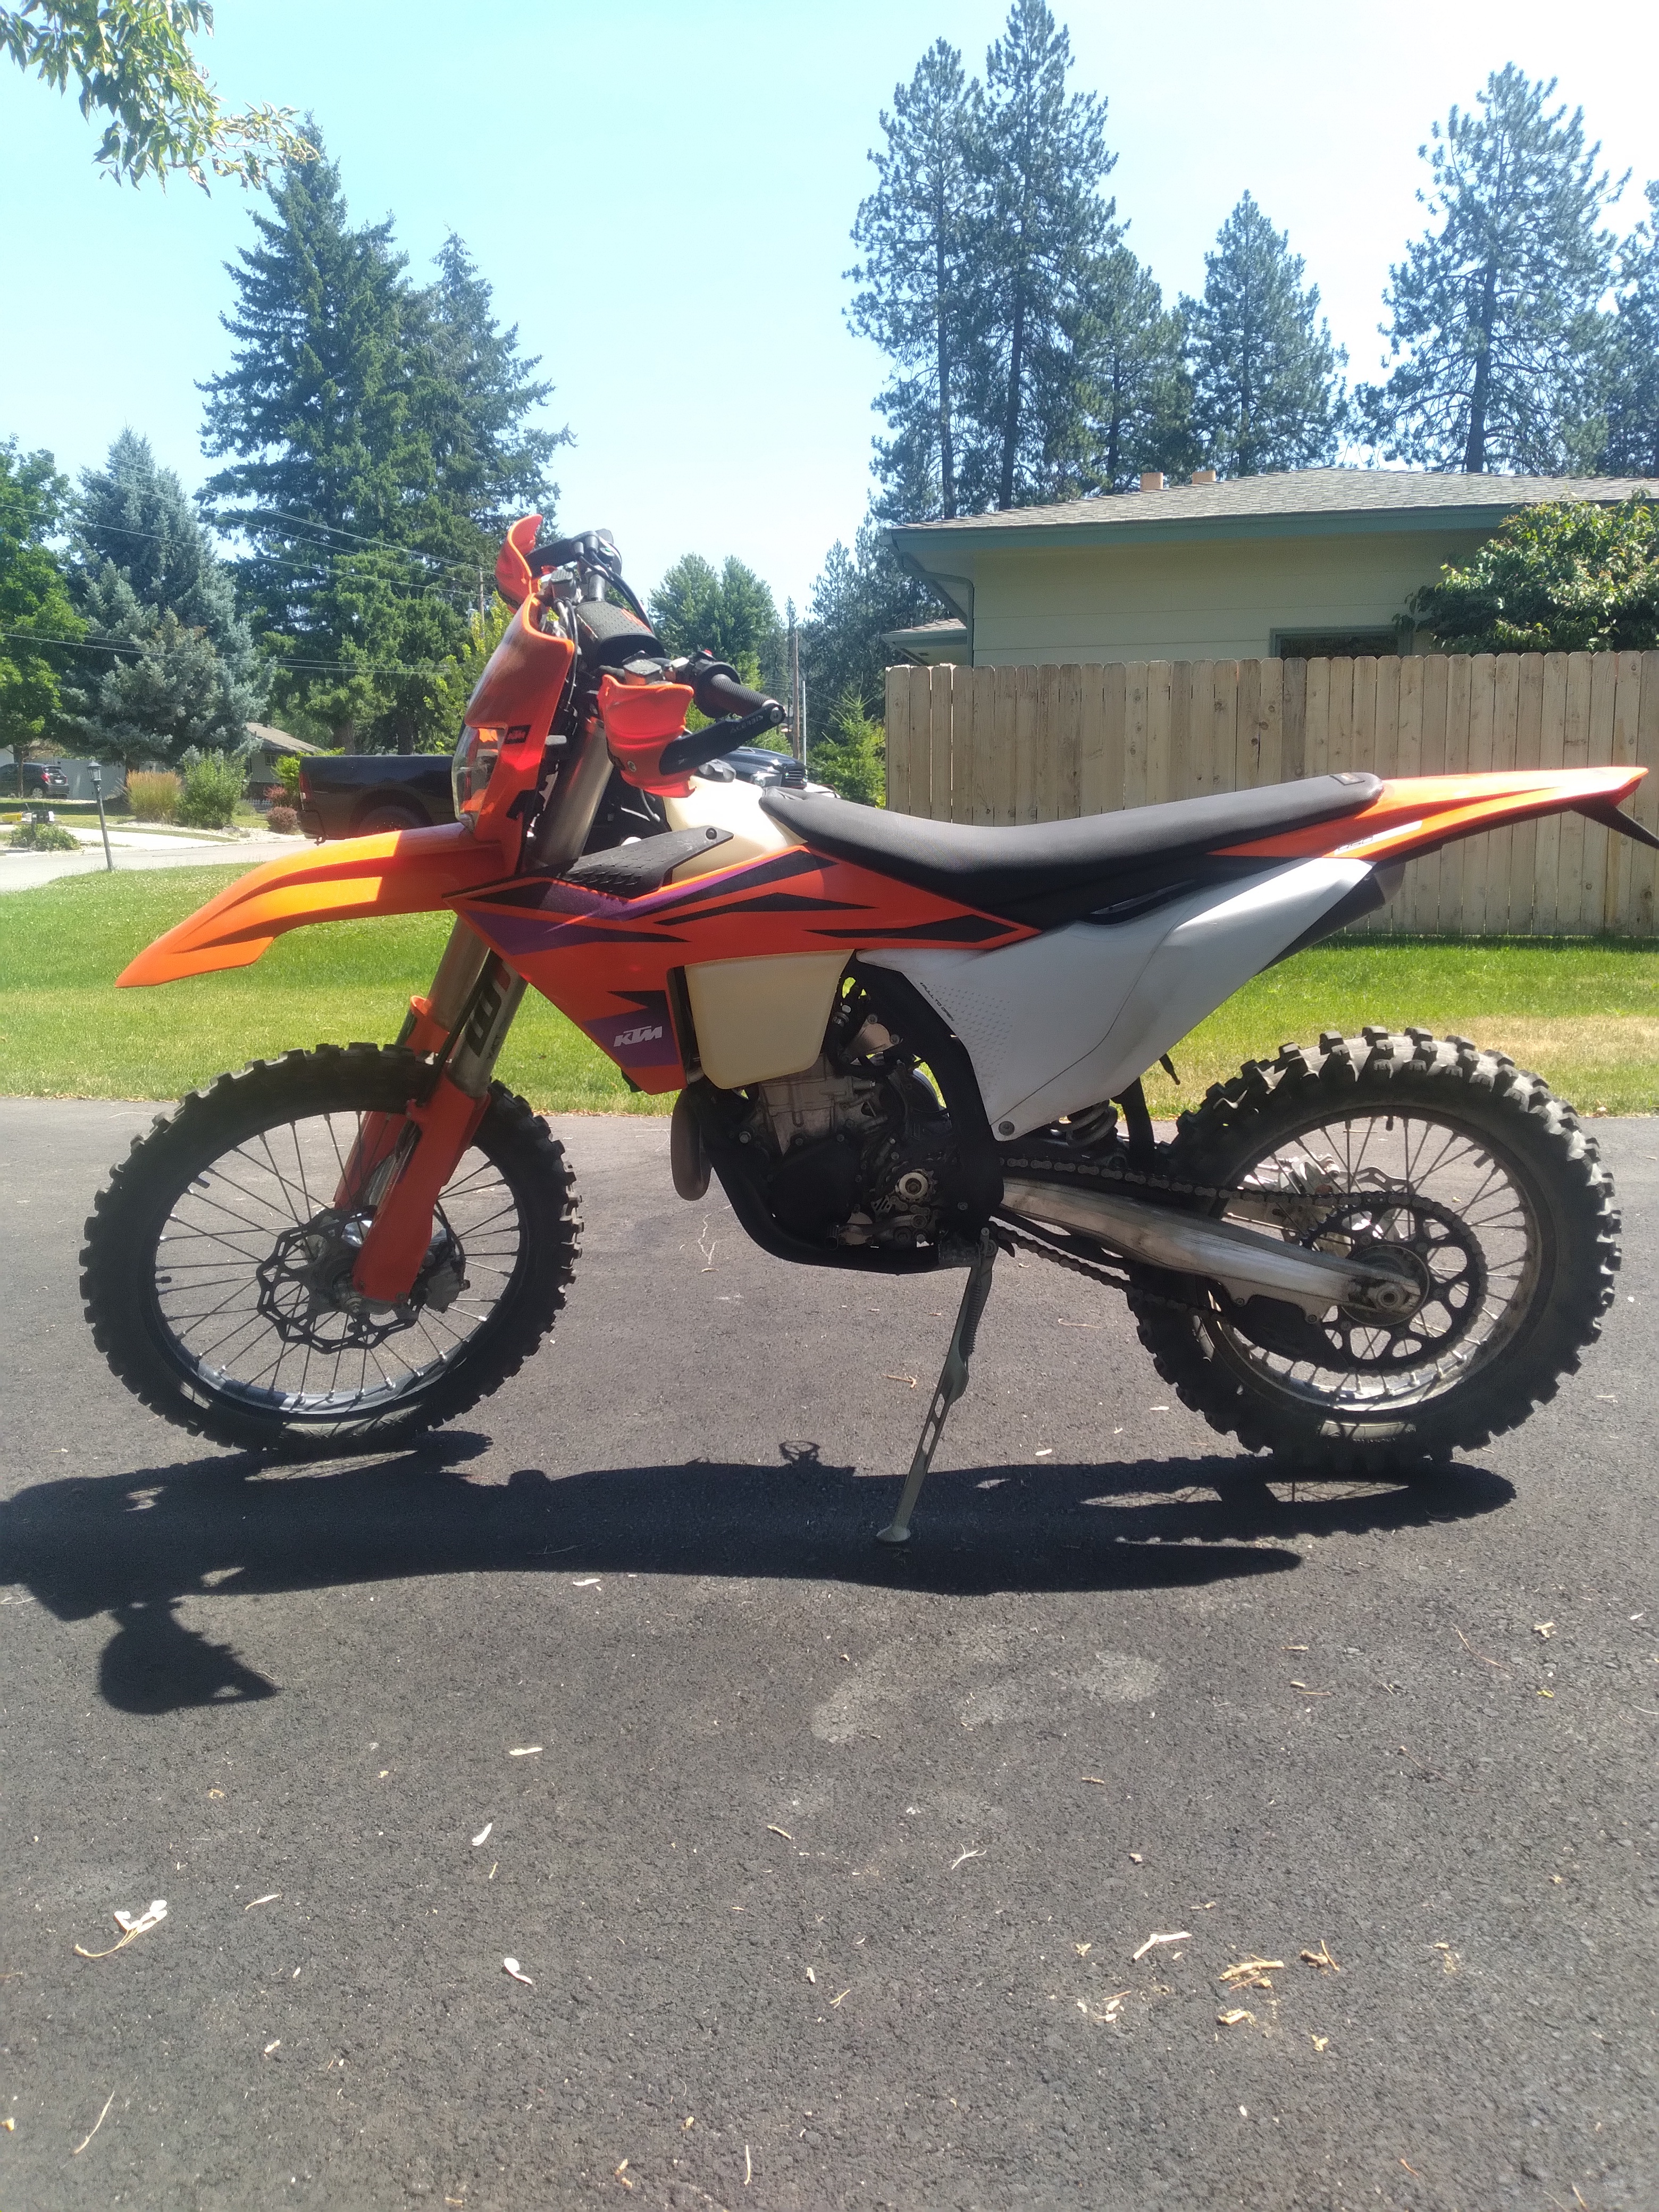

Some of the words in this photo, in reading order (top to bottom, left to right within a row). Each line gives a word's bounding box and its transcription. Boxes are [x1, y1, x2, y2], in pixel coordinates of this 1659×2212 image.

[730, 715, 764, 734] ACERBIS
[921, 984, 934, 999] PULL
[935, 998, 942, 1007] TO
[941, 1007, 955, 1021] OPEN
[613, 1025, 663, 1047] KTM
